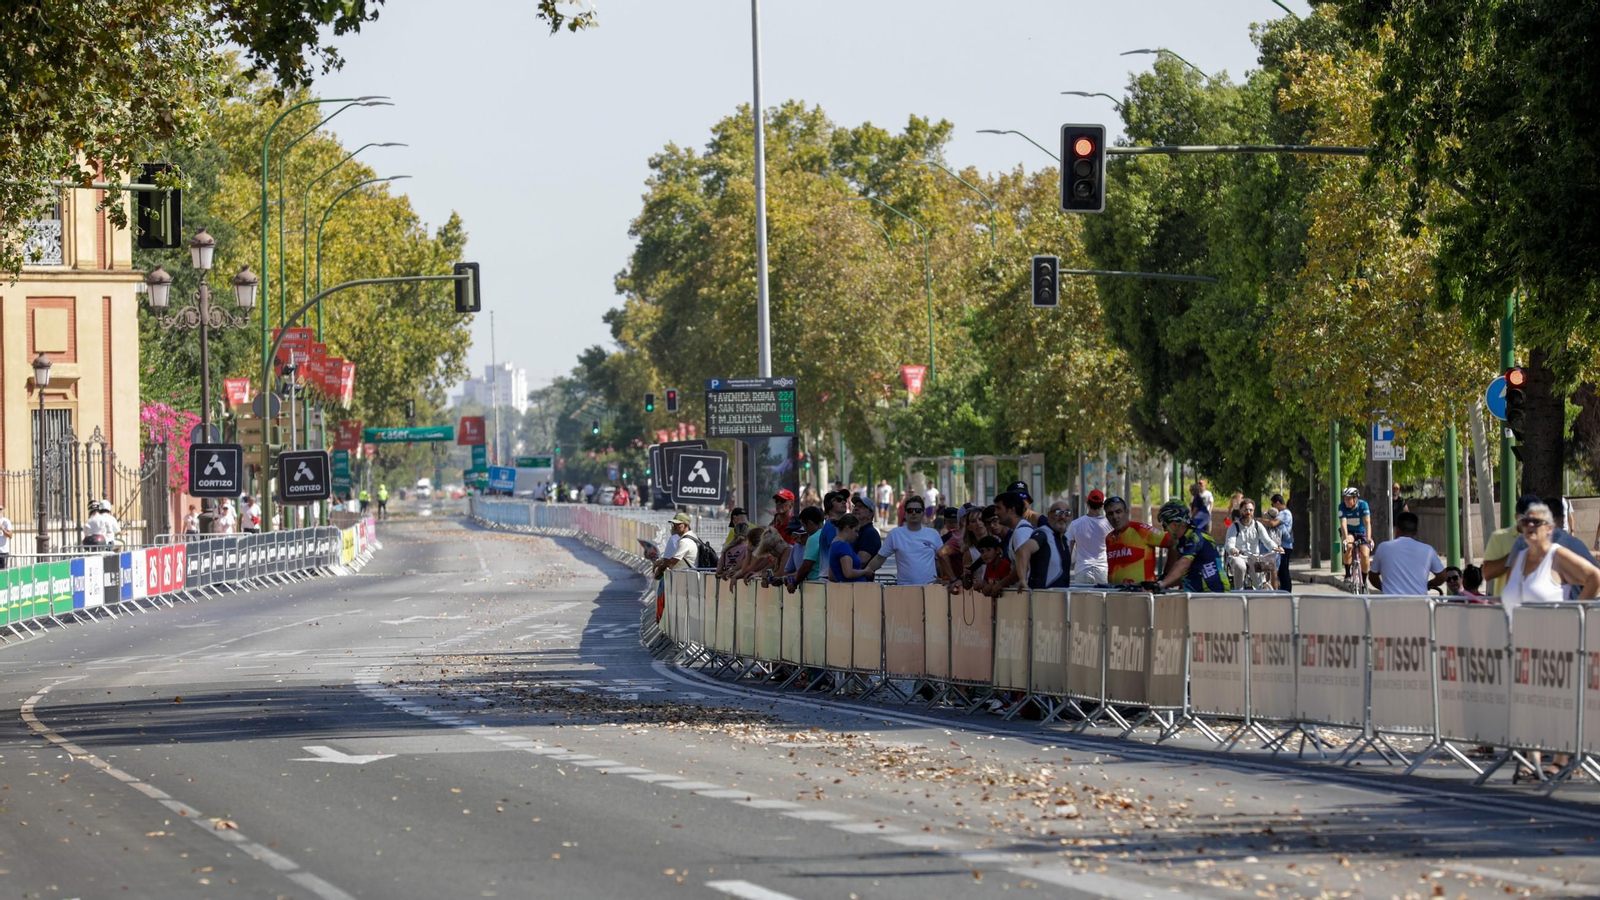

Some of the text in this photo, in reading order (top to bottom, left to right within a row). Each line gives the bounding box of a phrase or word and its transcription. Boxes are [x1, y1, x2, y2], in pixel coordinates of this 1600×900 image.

[711, 380, 719, 388] P
[718, 391, 794, 402] AVENIDA ROMA 224
[718, 404, 734, 413] SAN
[780, 402, 794, 412] 121
[718, 414, 762, 424] M.DELICIAS
[382, 430, 409, 440] caser
[465, 421, 471, 433] 1
[682, 486, 716, 494] CORTIZO
[1108, 547, 1132, 558] SPAÑA
[1034, 620, 1062, 663] Santini
[1071, 622, 1099, 668] Santini
[1109, 626, 1145, 672] Santini
[1154, 628, 1183, 675] Santini
[1204, 632, 1239, 664] TISSOT
[1261, 634, 1290, 666] TISSOT
[1317, 634, 1359, 668] TISSOT
[1386, 637, 1426, 671] TISSOT
[1457, 647, 1503, 685] TISSOT
[1531, 649, 1573, 689] TISSOT
